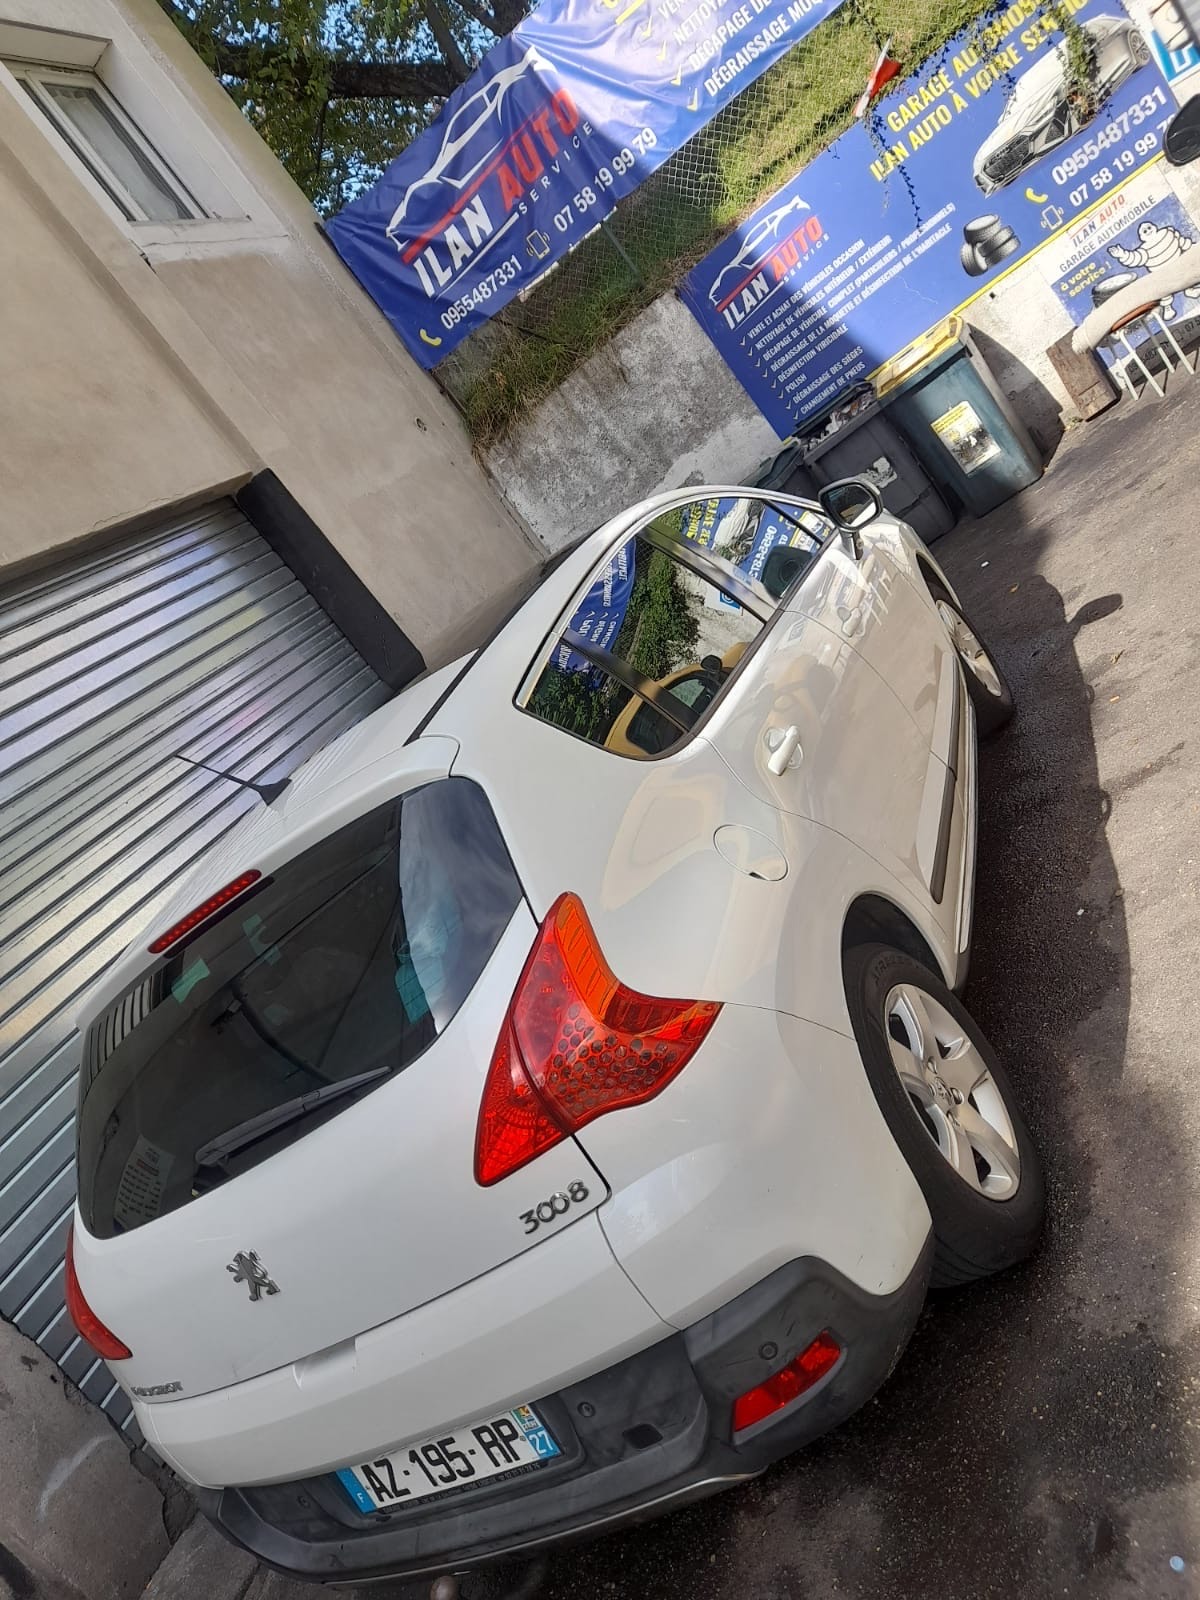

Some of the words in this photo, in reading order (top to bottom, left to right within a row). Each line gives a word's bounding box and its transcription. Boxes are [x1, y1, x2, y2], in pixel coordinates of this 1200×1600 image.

[689, 4, 754, 71] DÉCAPAGE
[704, 14, 791, 97] DÉGRAISSAGE
[870, 141, 909, 182] ILAN
[908, 104, 952, 151] AUTO
[948, 89, 968, 114] À
[964, 43, 1022, 98] VOTRE
[887, 67, 954, 132] GARAGE
[519, 121, 593, 215] SERVICE
[1052, 86, 1167, 184] 0955487331
[1070, 182, 1088, 207] 07
[1090, 167, 1112, 190] 58
[1112, 150, 1134, 172] 19
[1134, 132, 1158, 156] 99
[413, 194, 494, 297] ILAN
[496, 87, 580, 213] AUTO
[1072, 221, 1096, 248] ILAN
[1100, 194, 1126, 224] AUTO
[440, 254, 523, 330] 0955487331
[554, 209, 574, 233] 07
[574, 186, 596, 213] 58
[595, 166, 614, 192] 19
[612, 148, 635, 176] 99
[632, 127, 658, 154] 79
[784, 233, 830, 282] SERVICE
[1060, 243, 1096, 272] GARAGE
[1099, 194, 1156, 244] AUTOMOBILE
[722, 271, 770, 330] ILAN
[770, 215, 823, 282] AUTO
[747, 322, 766, 339] VENTE
[764, 316, 772, 326] ET
[772, 300, 792, 320] ACHAT
[790, 290, 804, 304] DES
[801, 264, 834, 294] VÉHICULES
[832, 238, 864, 268] OCCASION
[754, 322, 788, 350] NETTOYAGE
[785, 315, 796, 326] DE
[793, 289, 826, 318] VÉHICULES
[824, 265, 856, 294] INTÉRIEUR
[858, 234, 892, 266] EXTÉRIEUR
[1061, 282, 1069, 290] à
[1068, 262, 1096, 284] votre
[1069, 266, 1106, 297] service
[763, 334, 792, 361] DÉCAPAGE
[790, 328, 800, 338] DE
[799, 306, 828, 332] VÉHICULE
[828, 282, 855, 308] COMPLET
[770, 338, 810, 372] DÉGRAISSAGE
[807, 332, 818, 343] DE
[815, 325, 826, 336] LA
[824, 300, 856, 329] MOQUETTE
[778, 348, 816, 382] DÉSINFECTION
[815, 322, 848, 352] VIRICIDALE
[784, 372, 808, 393] POLISH
[792, 370, 831, 404] DÉGRAISSAGE
[829, 362, 843, 375] DES
[841, 346, 864, 366] SIÈGES
[800, 382, 838, 414] CHANGEMENT
[836, 376, 846, 387] DE
[844, 362, 866, 380] PNEUS
[518, 1179, 590, 1235] 3008
[528, 1430, 554, 1454] 27
[356, 1492, 364, 1504] F
